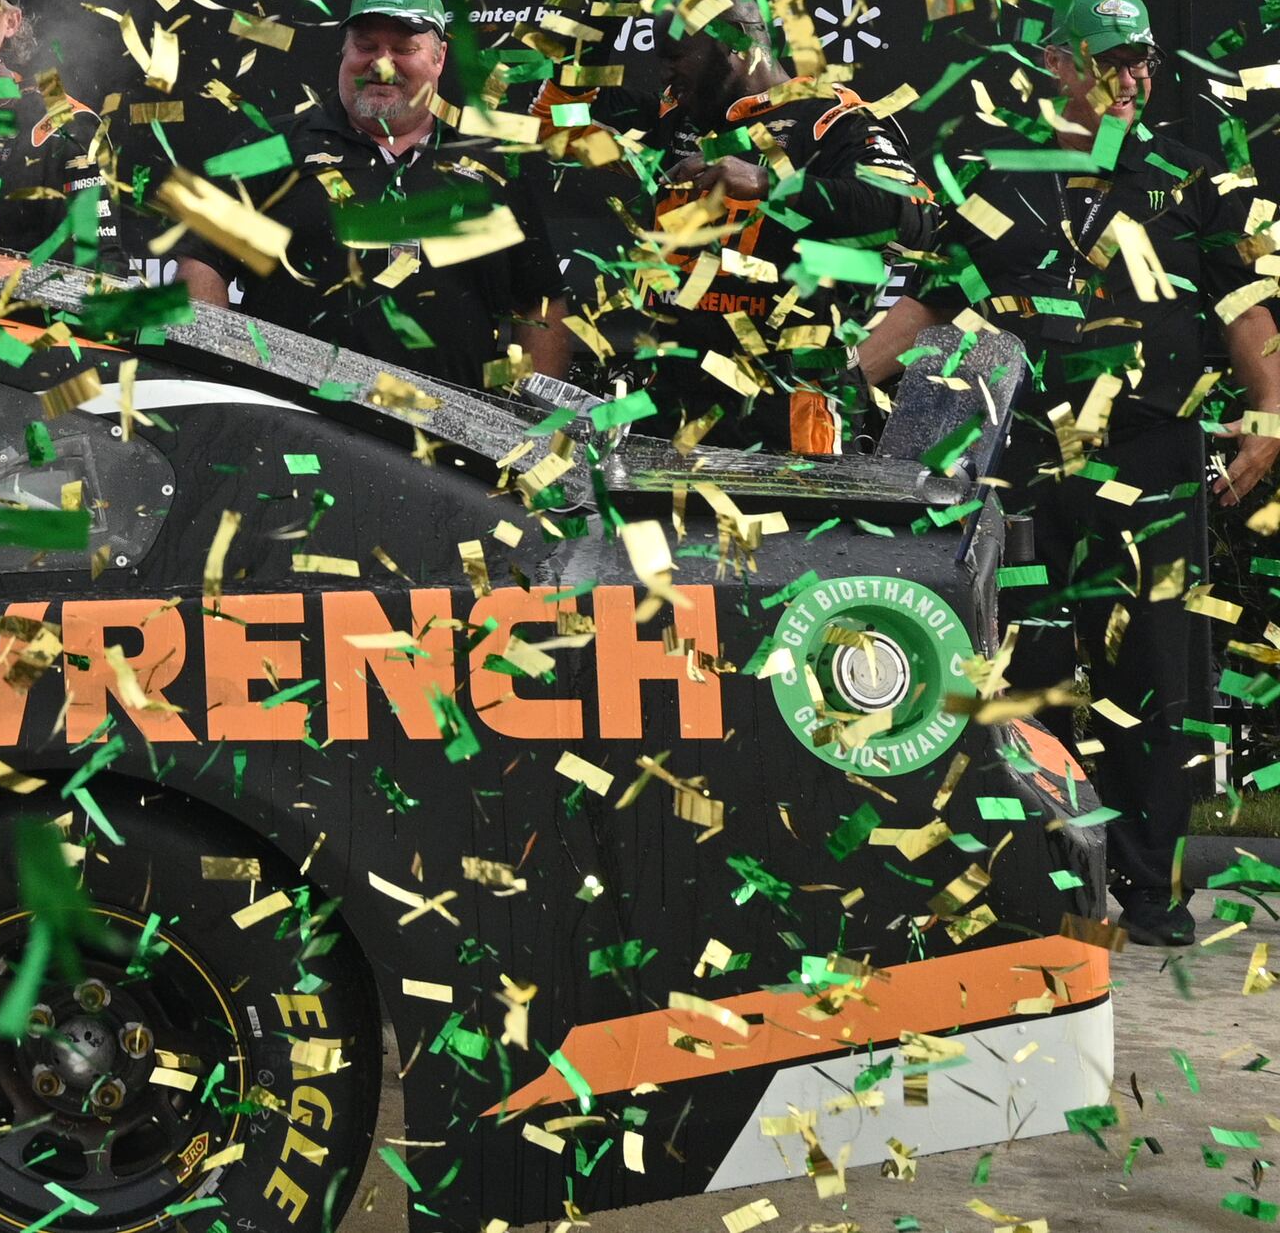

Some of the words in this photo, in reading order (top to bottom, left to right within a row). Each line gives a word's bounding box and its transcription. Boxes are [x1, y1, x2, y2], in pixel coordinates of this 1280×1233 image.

[781, 602, 817, 648] GET
[812, 579, 957, 641] BIOETHANOL
[263, 993, 333, 1224] EGLE
